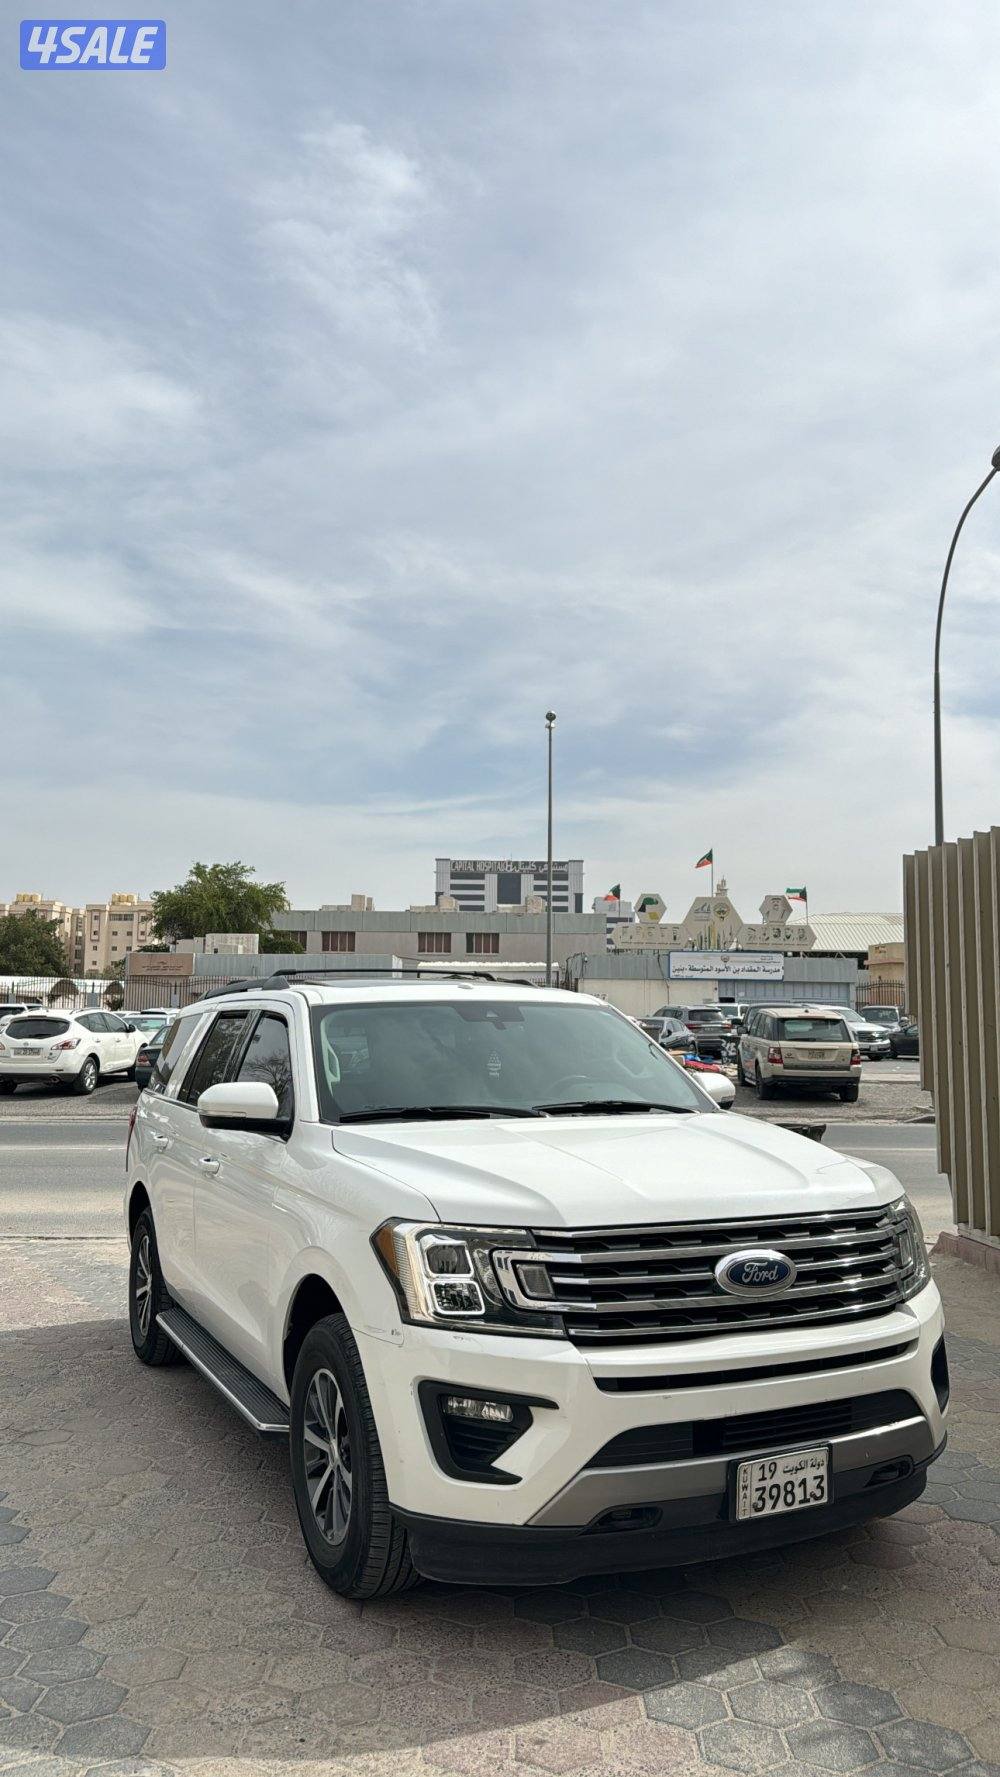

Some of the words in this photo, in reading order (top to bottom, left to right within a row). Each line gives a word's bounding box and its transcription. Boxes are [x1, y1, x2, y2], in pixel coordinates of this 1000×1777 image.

[451, 861, 474, 871] CAPITAL
[476, 861, 505, 872] HOSPITAL
[688, 964, 713, 974] المتوسطة
[762, 965, 780, 975] مدرسة
[741, 1261, 779, 1283] Ford
[758, 1461, 778, 1482] 19
[782, 1459, 809, 1475] الكويت
[810, 1457, 825, 1470] دولة
[741, 1467, 749, 1516] KUWAIT
[752, 1475, 825, 1513] 39813
